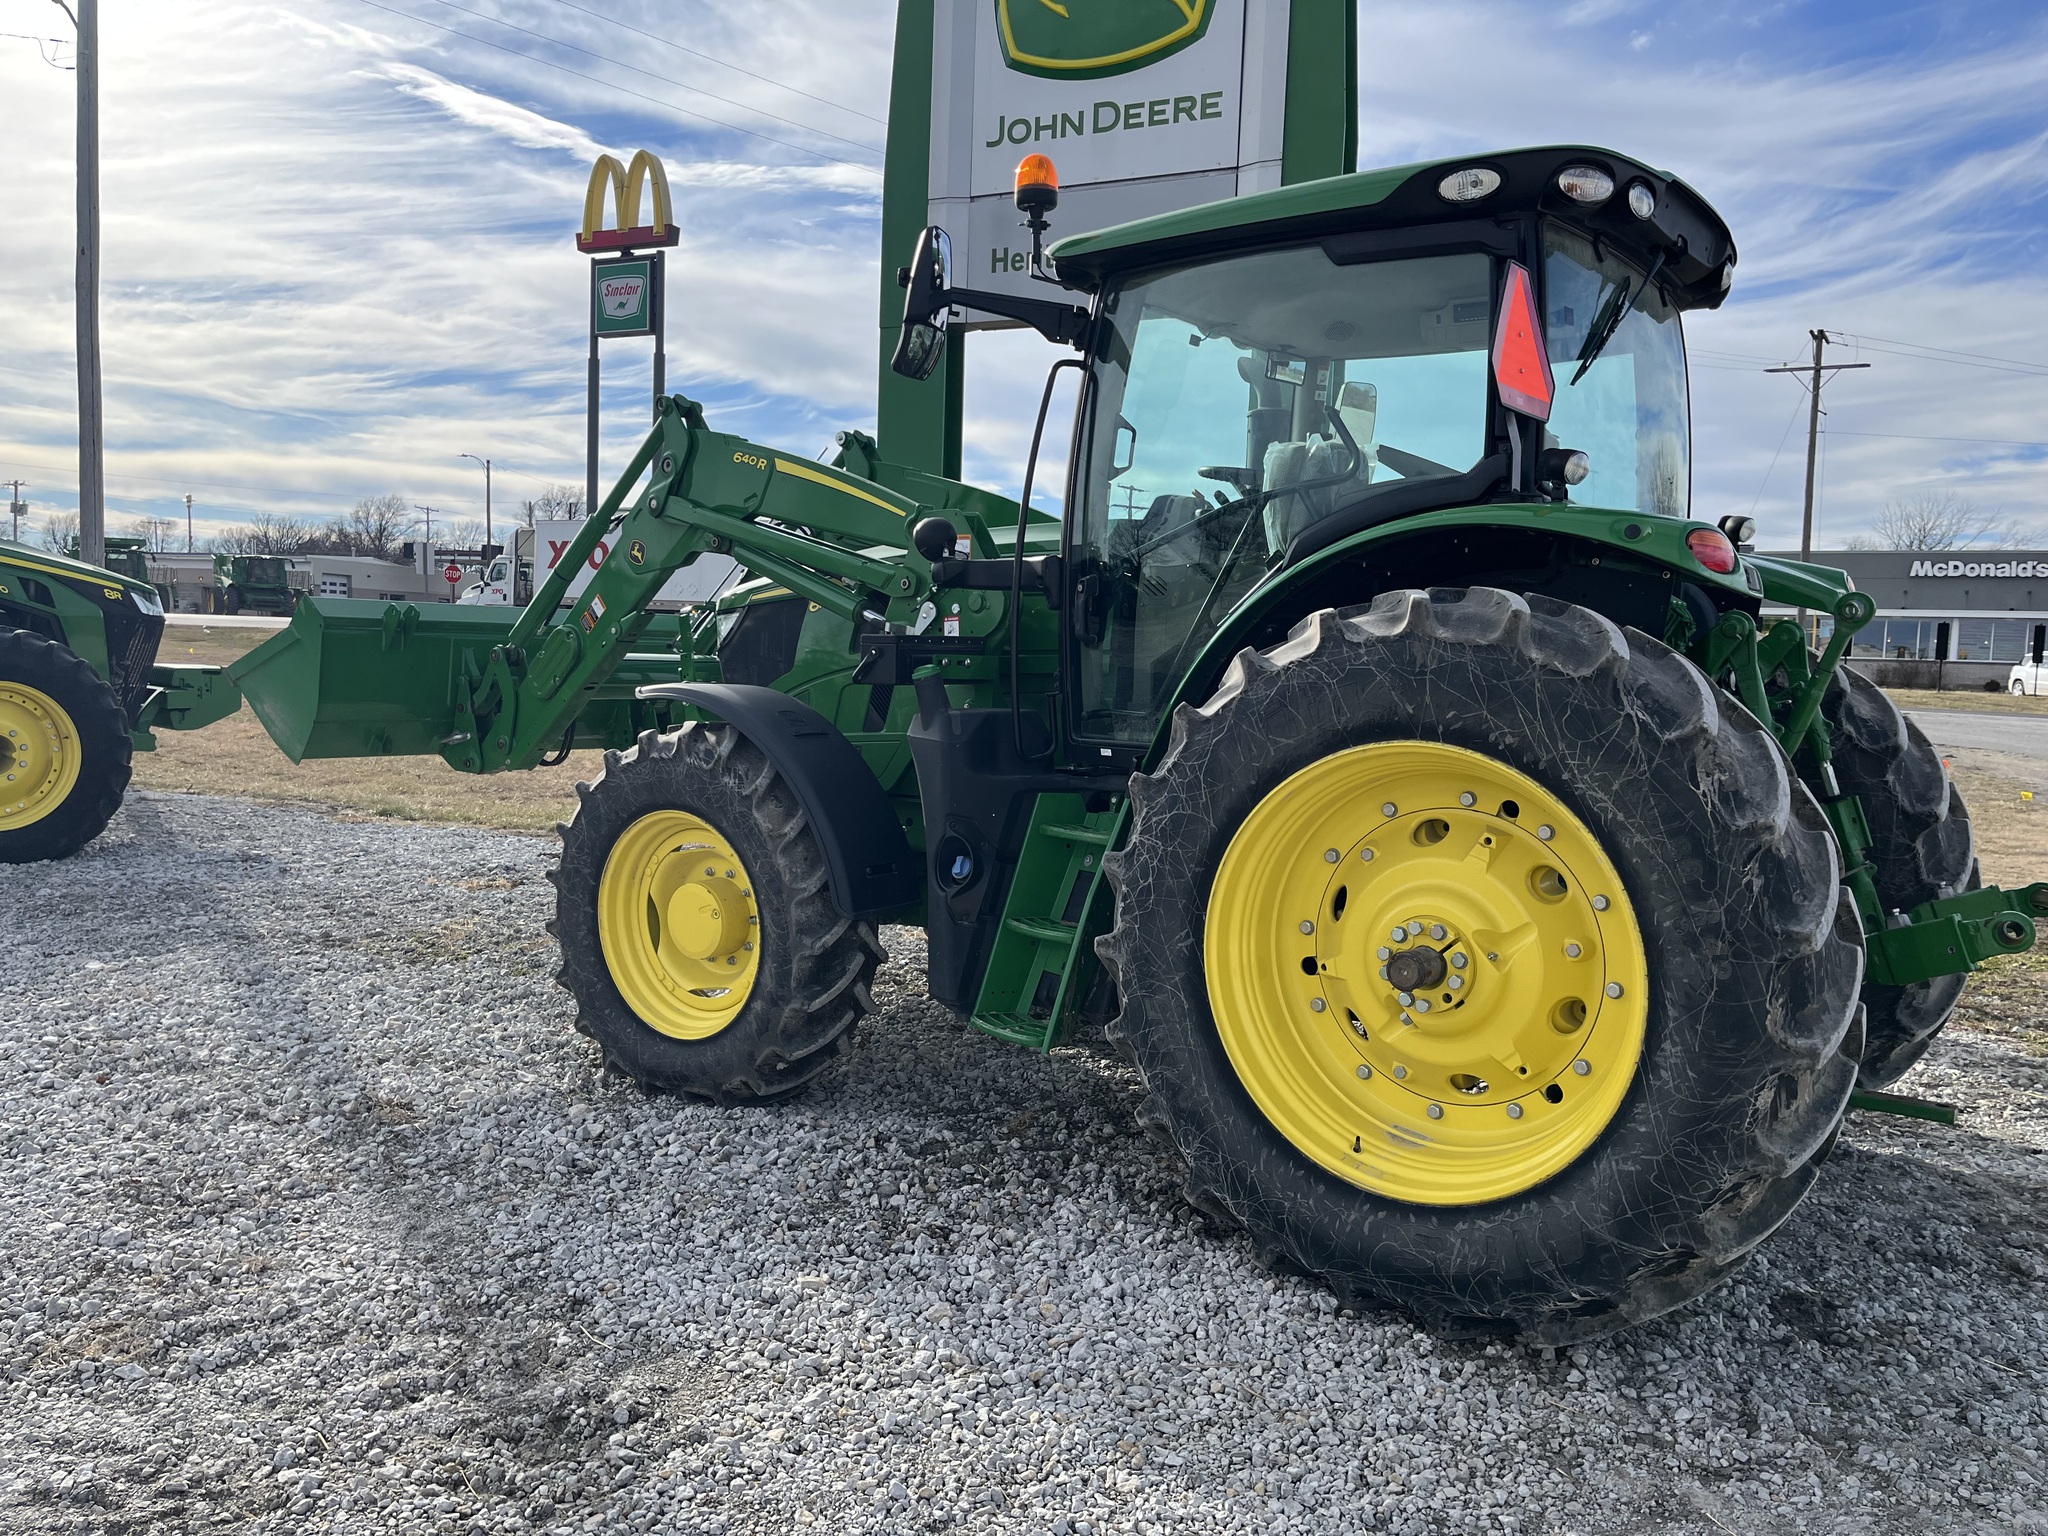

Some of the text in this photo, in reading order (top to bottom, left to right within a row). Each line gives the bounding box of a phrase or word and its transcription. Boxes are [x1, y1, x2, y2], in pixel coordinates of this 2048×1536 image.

[986, 91, 1224, 148] JOHN DEERE
[605, 283, 641, 297] Sinclair
[547, 540, 610, 570] XO
[445, 570, 461, 579] STOP
[1909, 560, 2048, 577] McDonald's
[103, 588, 122, 600] 8R
